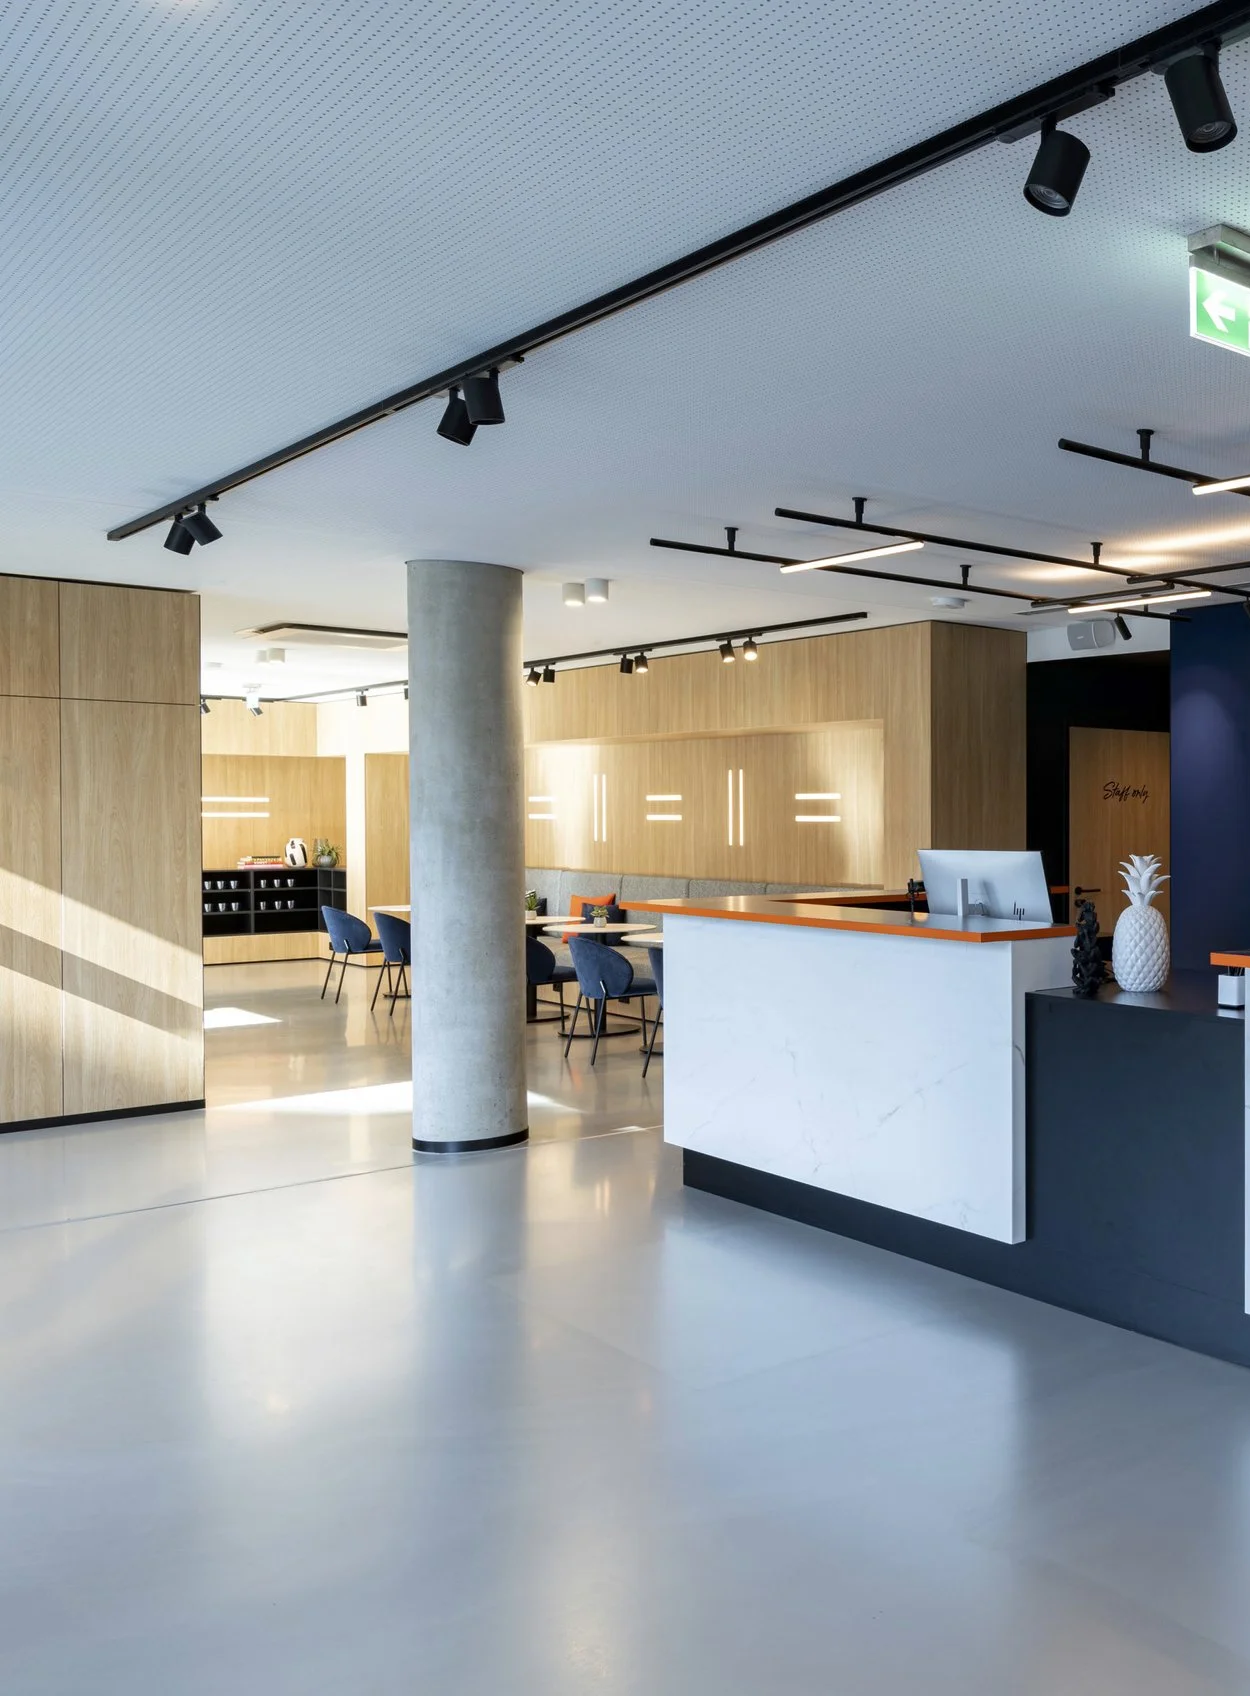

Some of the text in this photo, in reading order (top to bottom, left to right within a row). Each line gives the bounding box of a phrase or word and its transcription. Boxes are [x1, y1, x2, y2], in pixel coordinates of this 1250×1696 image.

[1103, 781, 1149, 803] Staff only
[1013, 901, 1025, 921] hp
